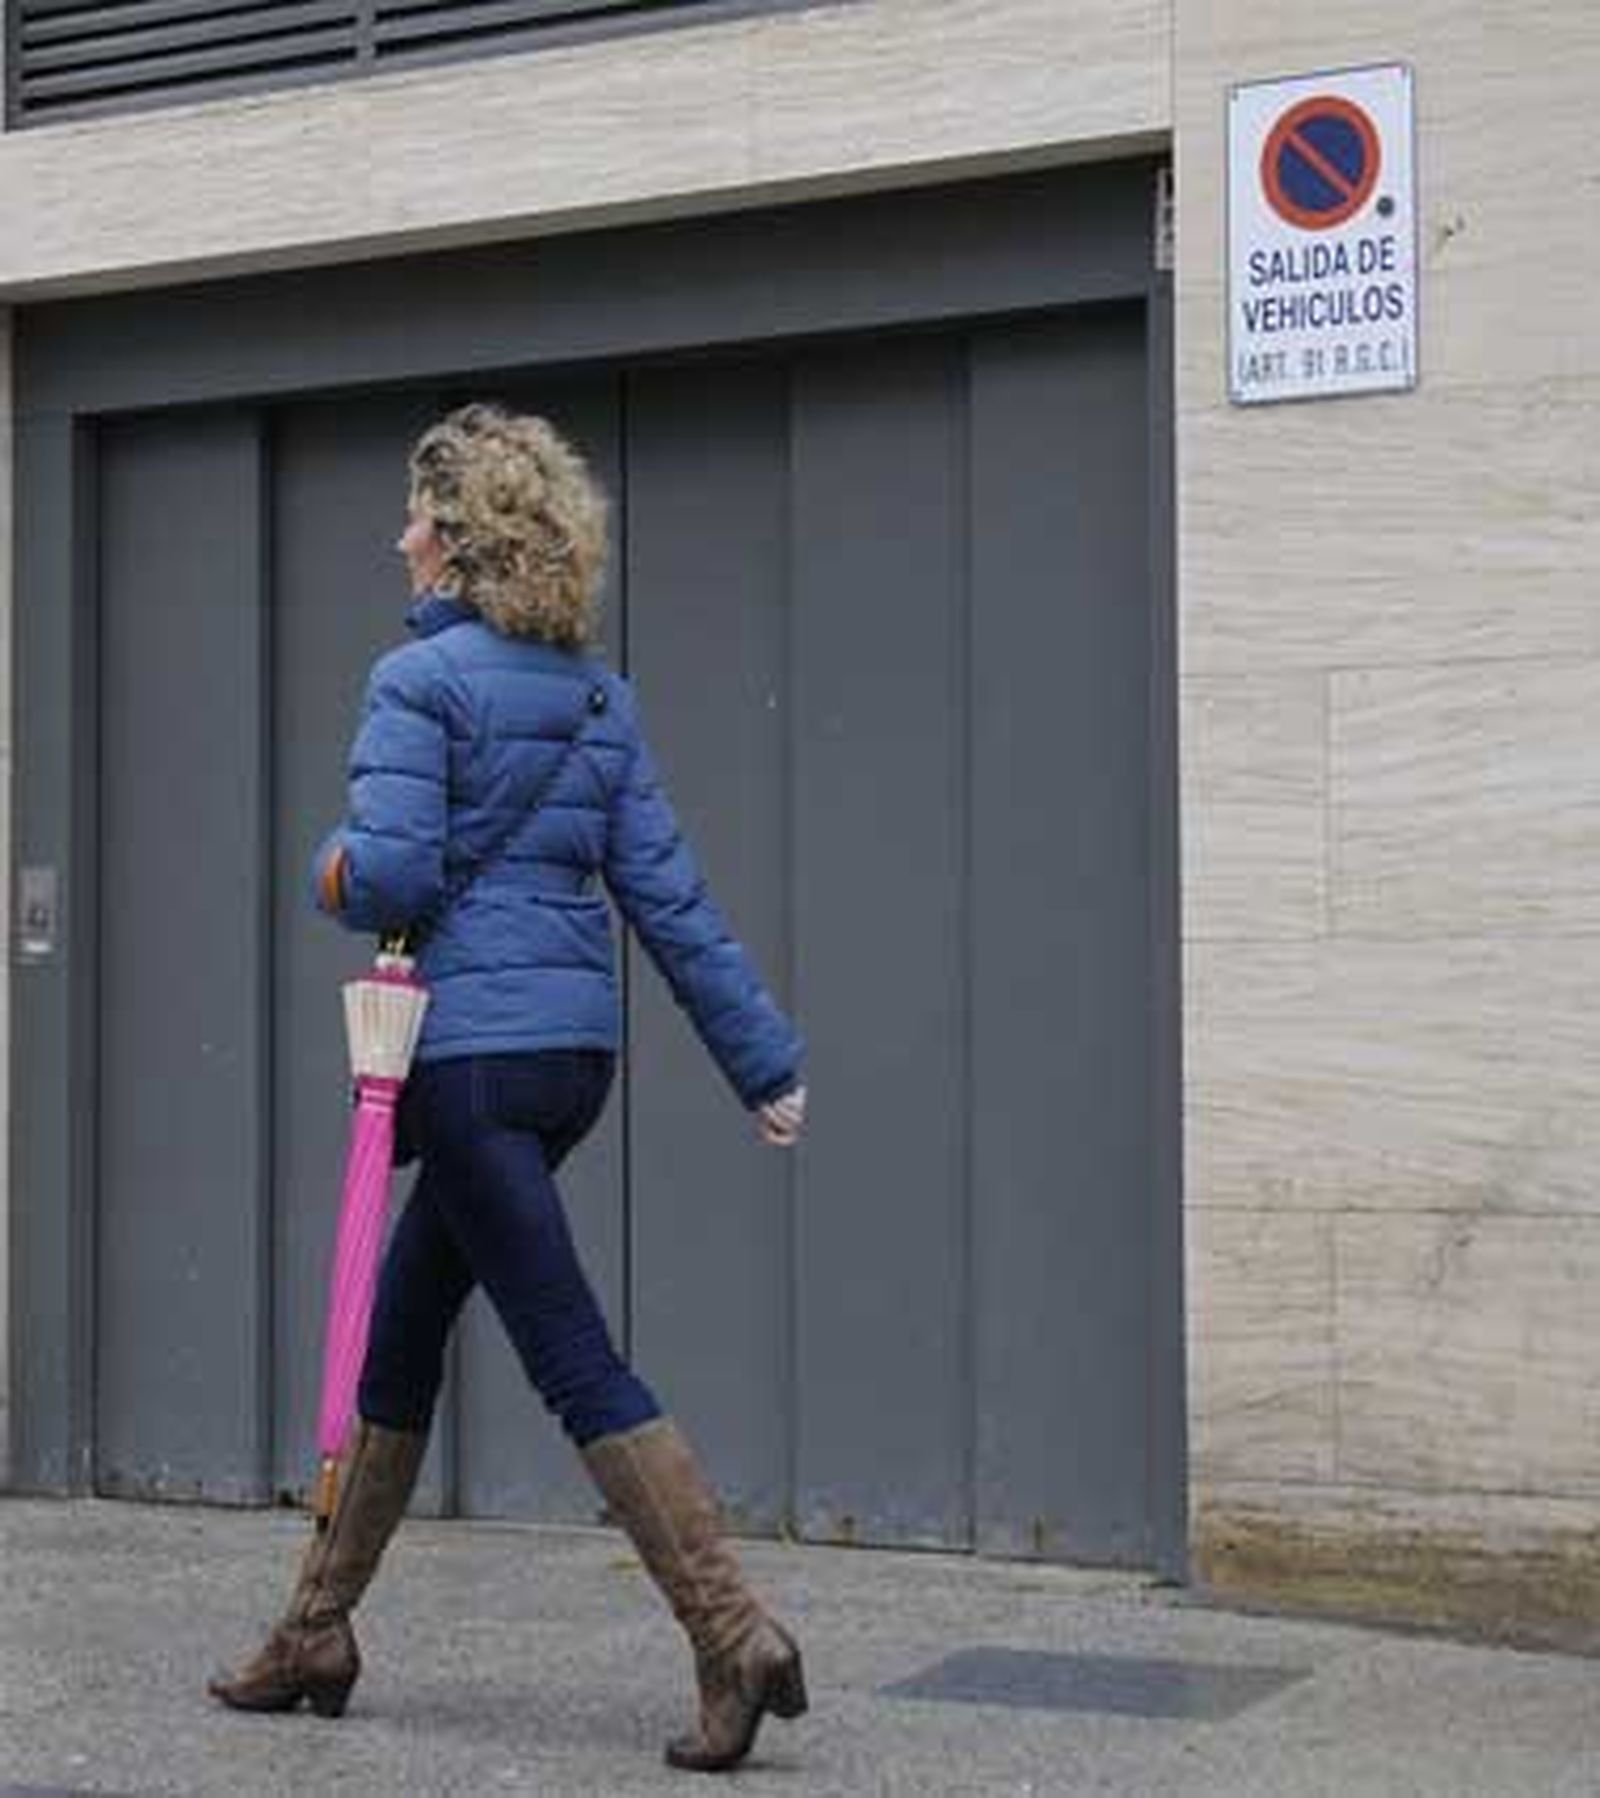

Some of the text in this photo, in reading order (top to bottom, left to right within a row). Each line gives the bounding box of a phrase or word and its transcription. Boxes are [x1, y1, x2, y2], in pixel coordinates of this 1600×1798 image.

[1249, 235, 1395, 287] SALIDA DE
[1242, 283, 1404, 332] VEHICULOS
